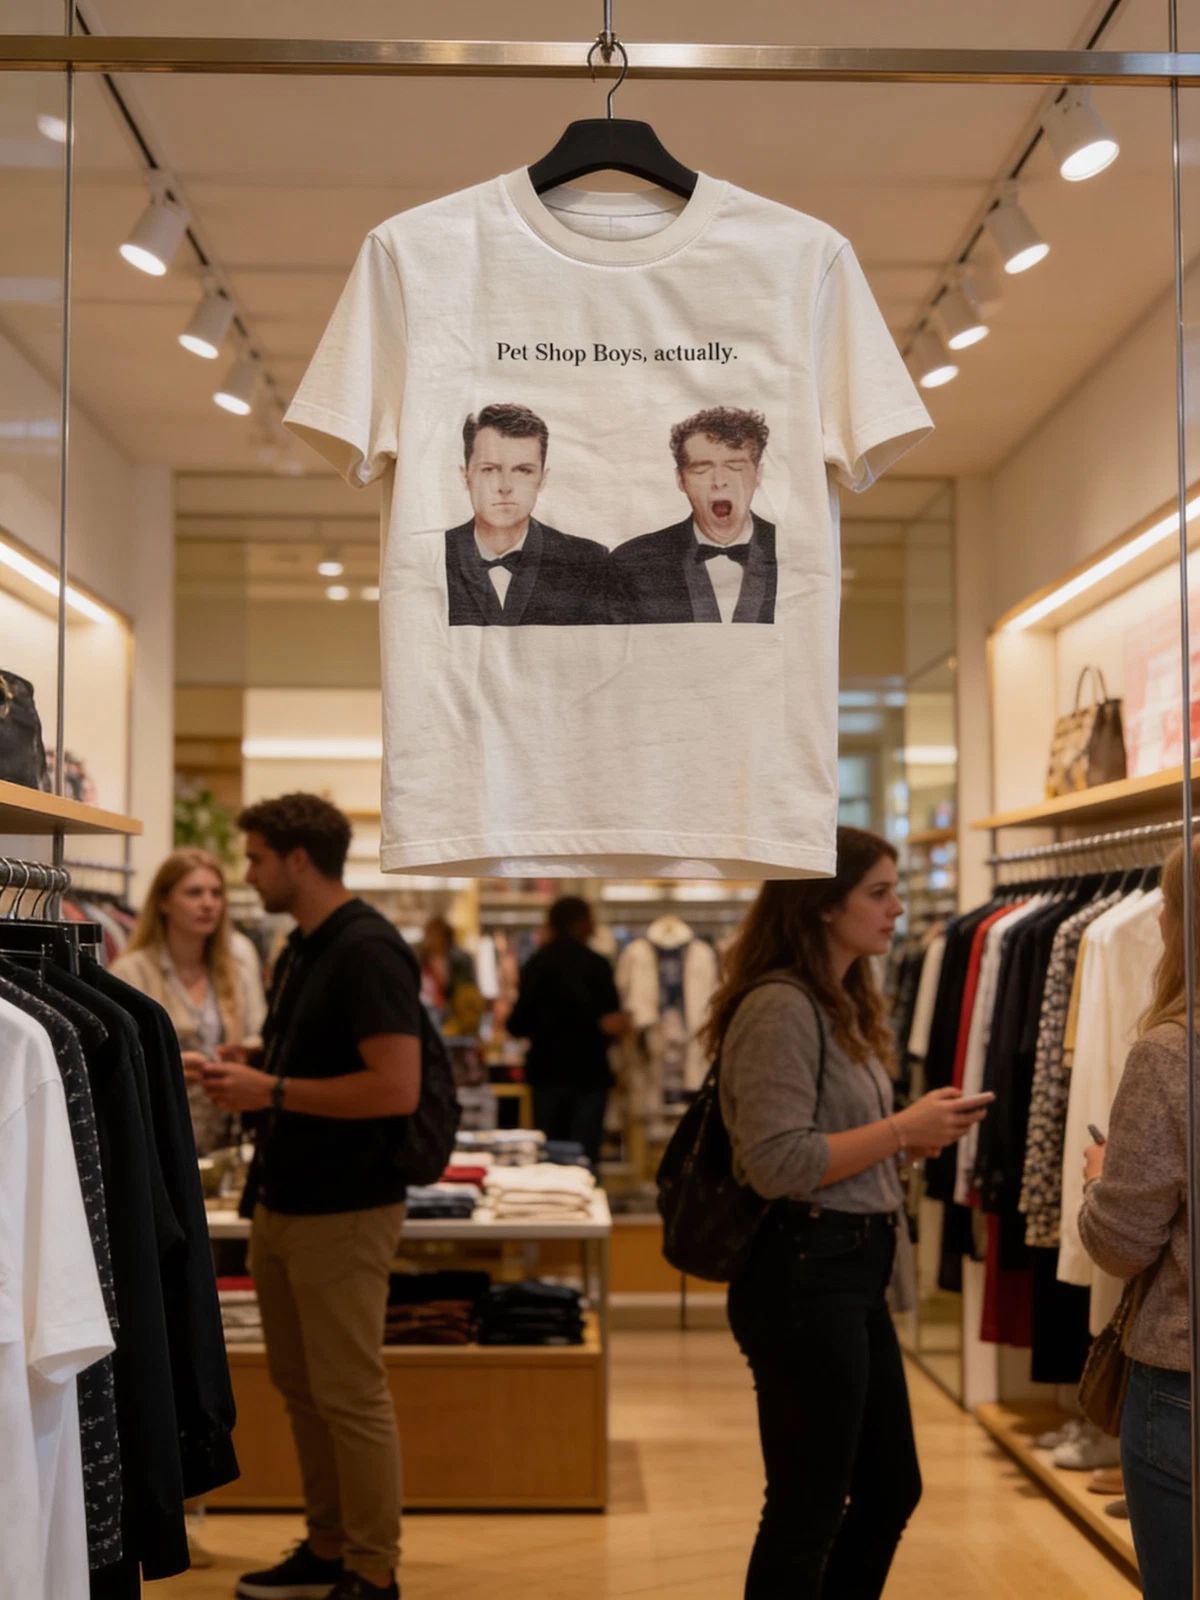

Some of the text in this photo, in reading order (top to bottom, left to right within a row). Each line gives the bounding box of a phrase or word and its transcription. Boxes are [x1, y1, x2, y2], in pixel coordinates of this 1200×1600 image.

[497, 341, 738, 367] Pet Shop Boys, actually.
